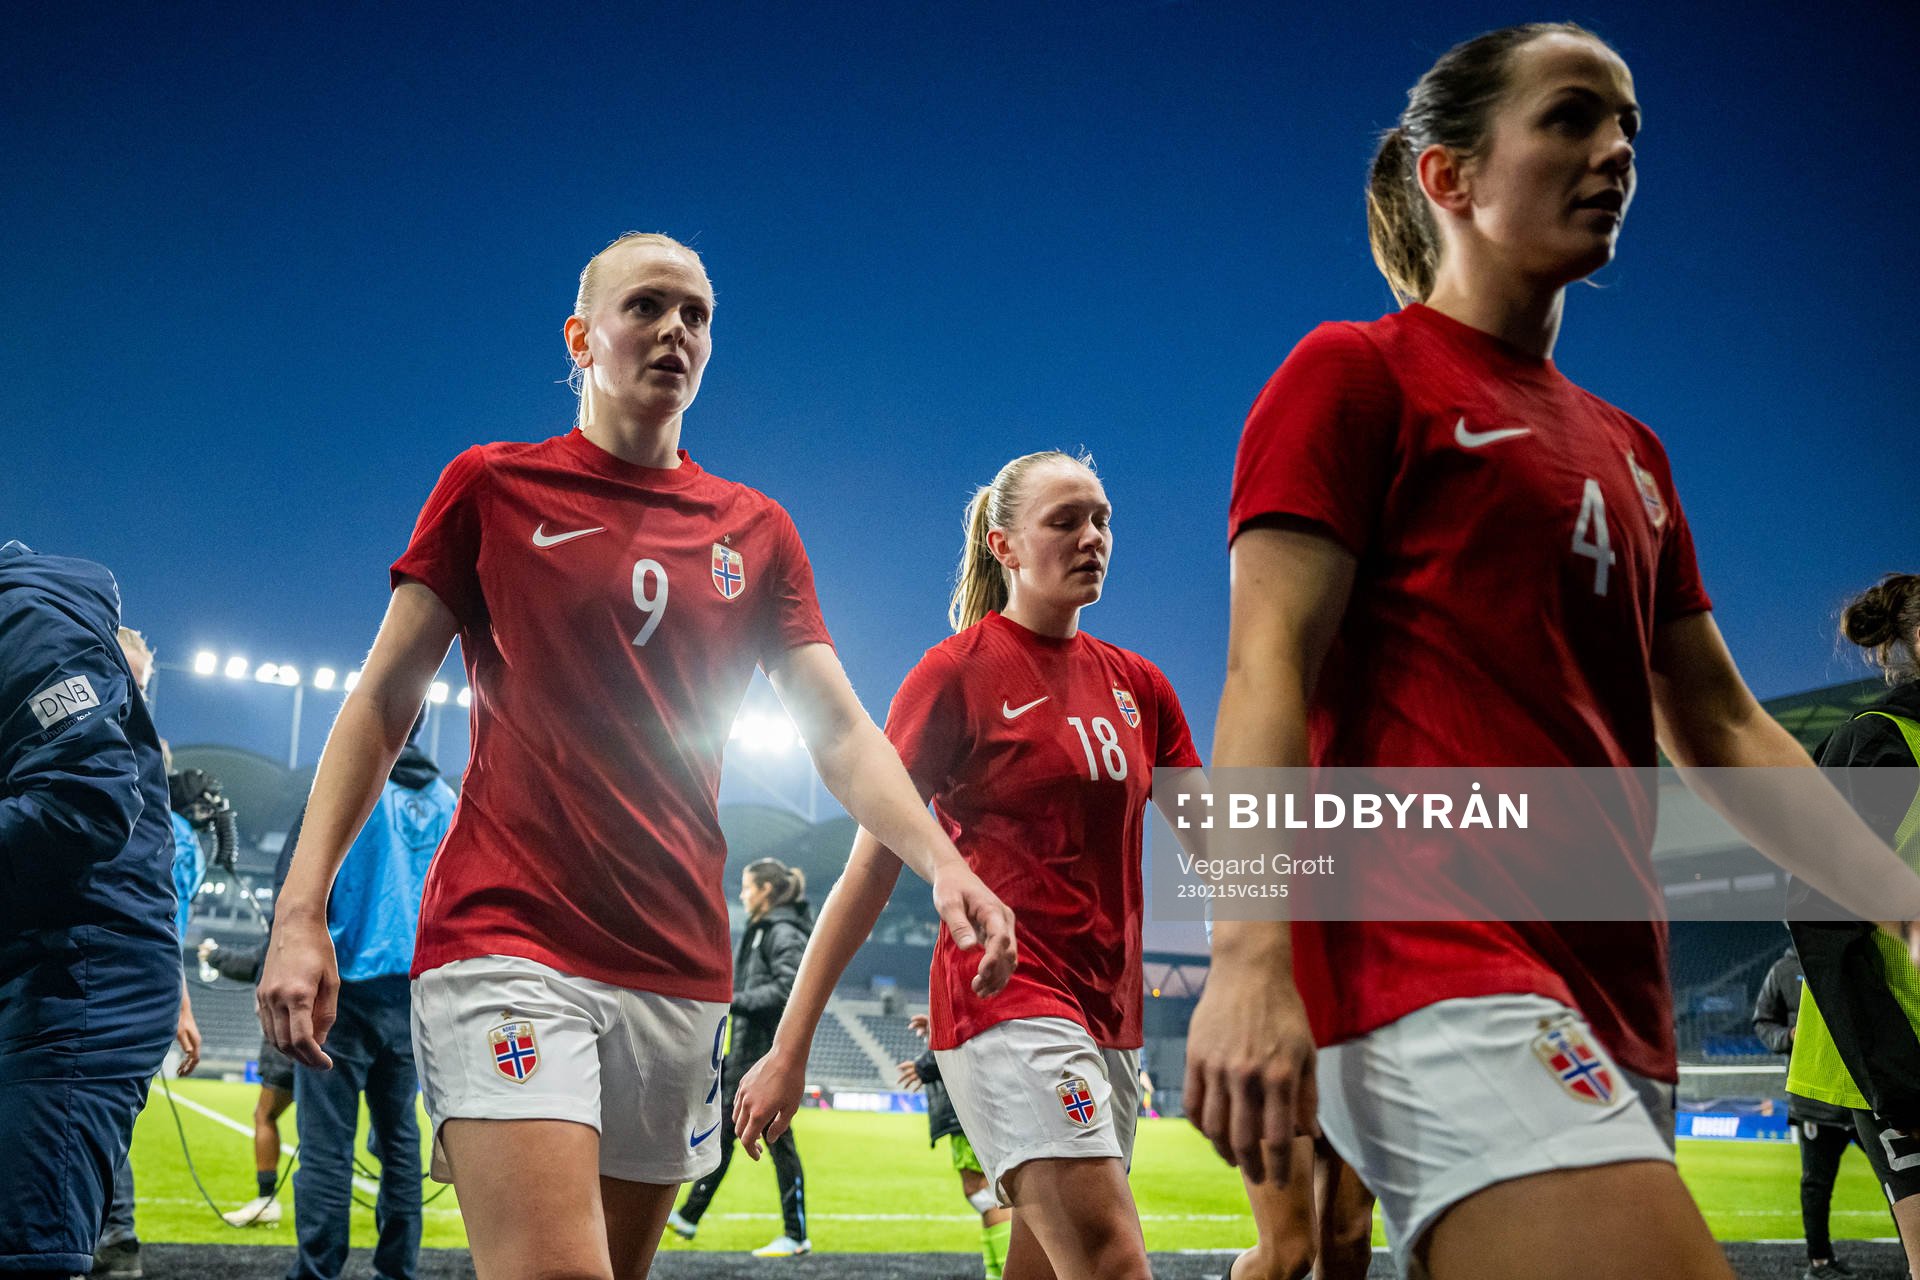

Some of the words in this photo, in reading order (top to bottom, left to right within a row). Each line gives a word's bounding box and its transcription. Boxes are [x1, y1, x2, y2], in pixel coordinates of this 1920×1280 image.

[1572, 478, 1616, 596] 4
[632, 558, 669, 646] 9
[40, 680, 90, 717] DNB
[1067, 717, 1128, 781] 18
